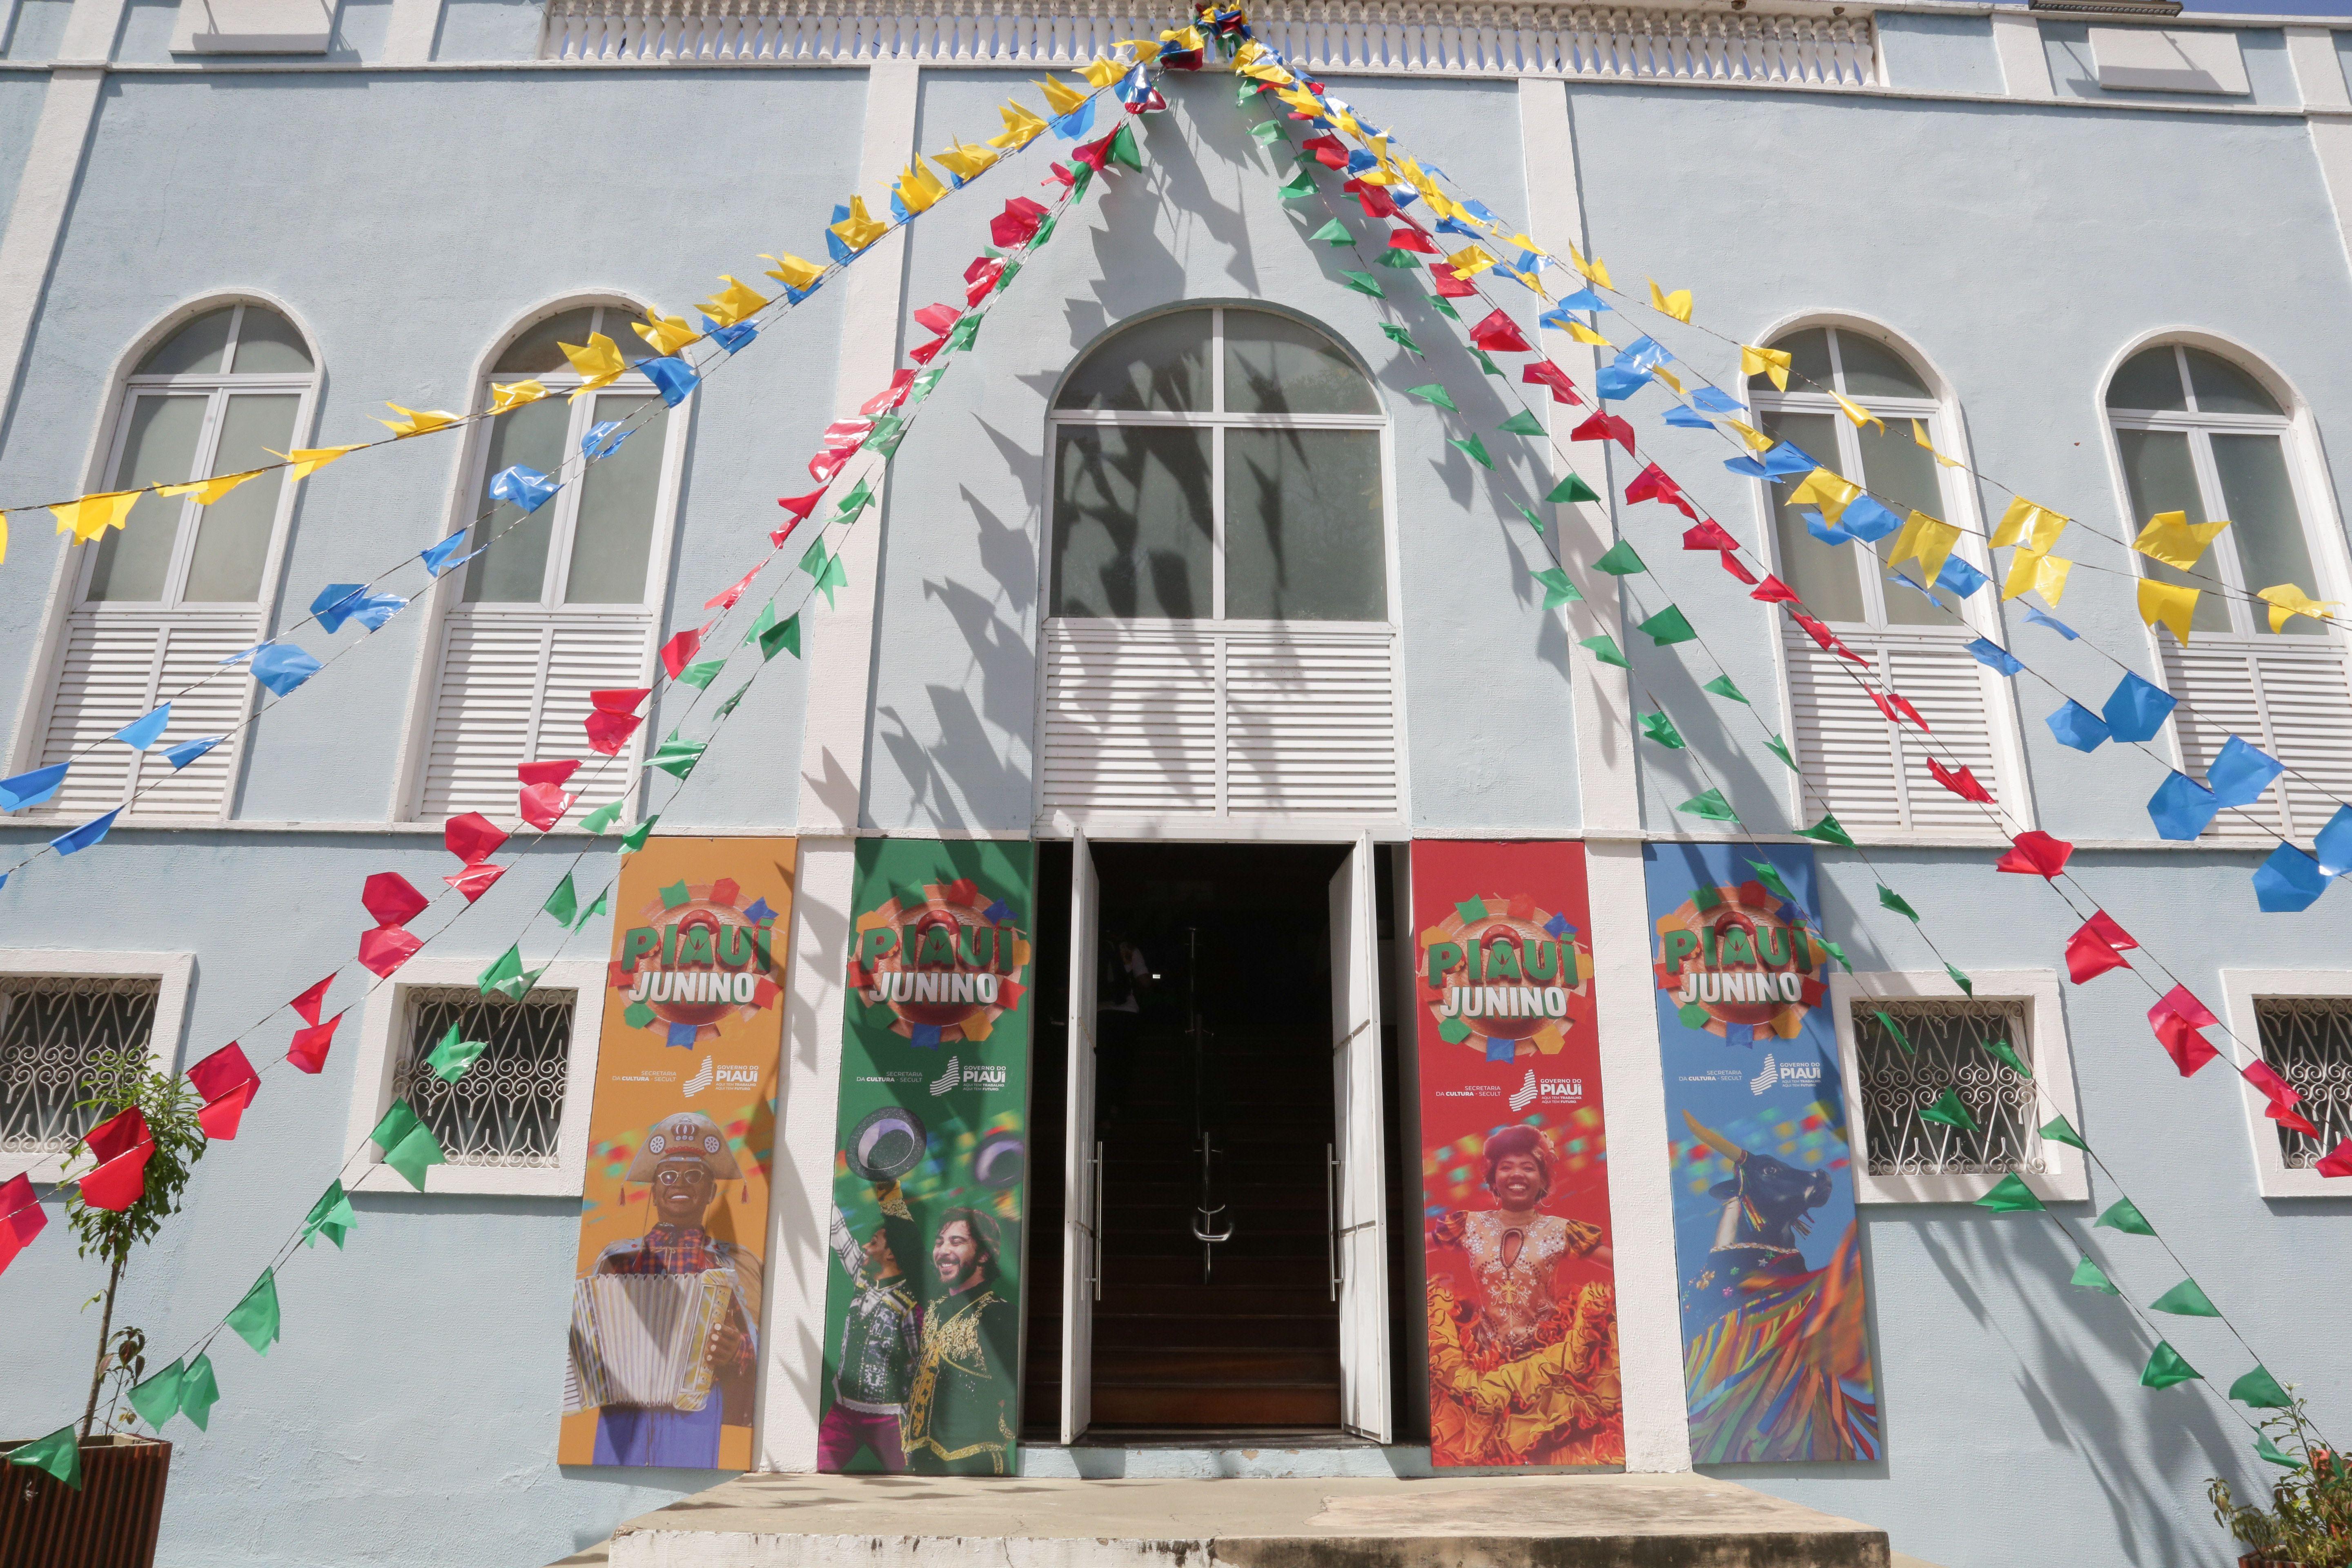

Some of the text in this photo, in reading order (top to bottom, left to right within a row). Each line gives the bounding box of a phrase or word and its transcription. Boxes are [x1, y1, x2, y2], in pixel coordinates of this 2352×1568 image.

[621, 918, 776, 974] PIAUÍ
[861, 919, 1016, 975] PIAUÍ
[1428, 932, 1579, 989] PIAUÍ
[1664, 919, 1813, 975] PIAUÍ
[628, 971, 755, 1003] JUNINO
[869, 972, 999, 1004] JUNINO
[1440, 986, 1567, 1018] JUNINO
[1678, 972, 1802, 1004] JUNINO
[716, 1070, 758, 1082] PIAUÍ
[964, 1071, 1005, 1082] PIAUÍ
[1780, 1067, 1821, 1079] PIAUÍ
[1541, 1084, 1582, 1095] PIAUÍ
